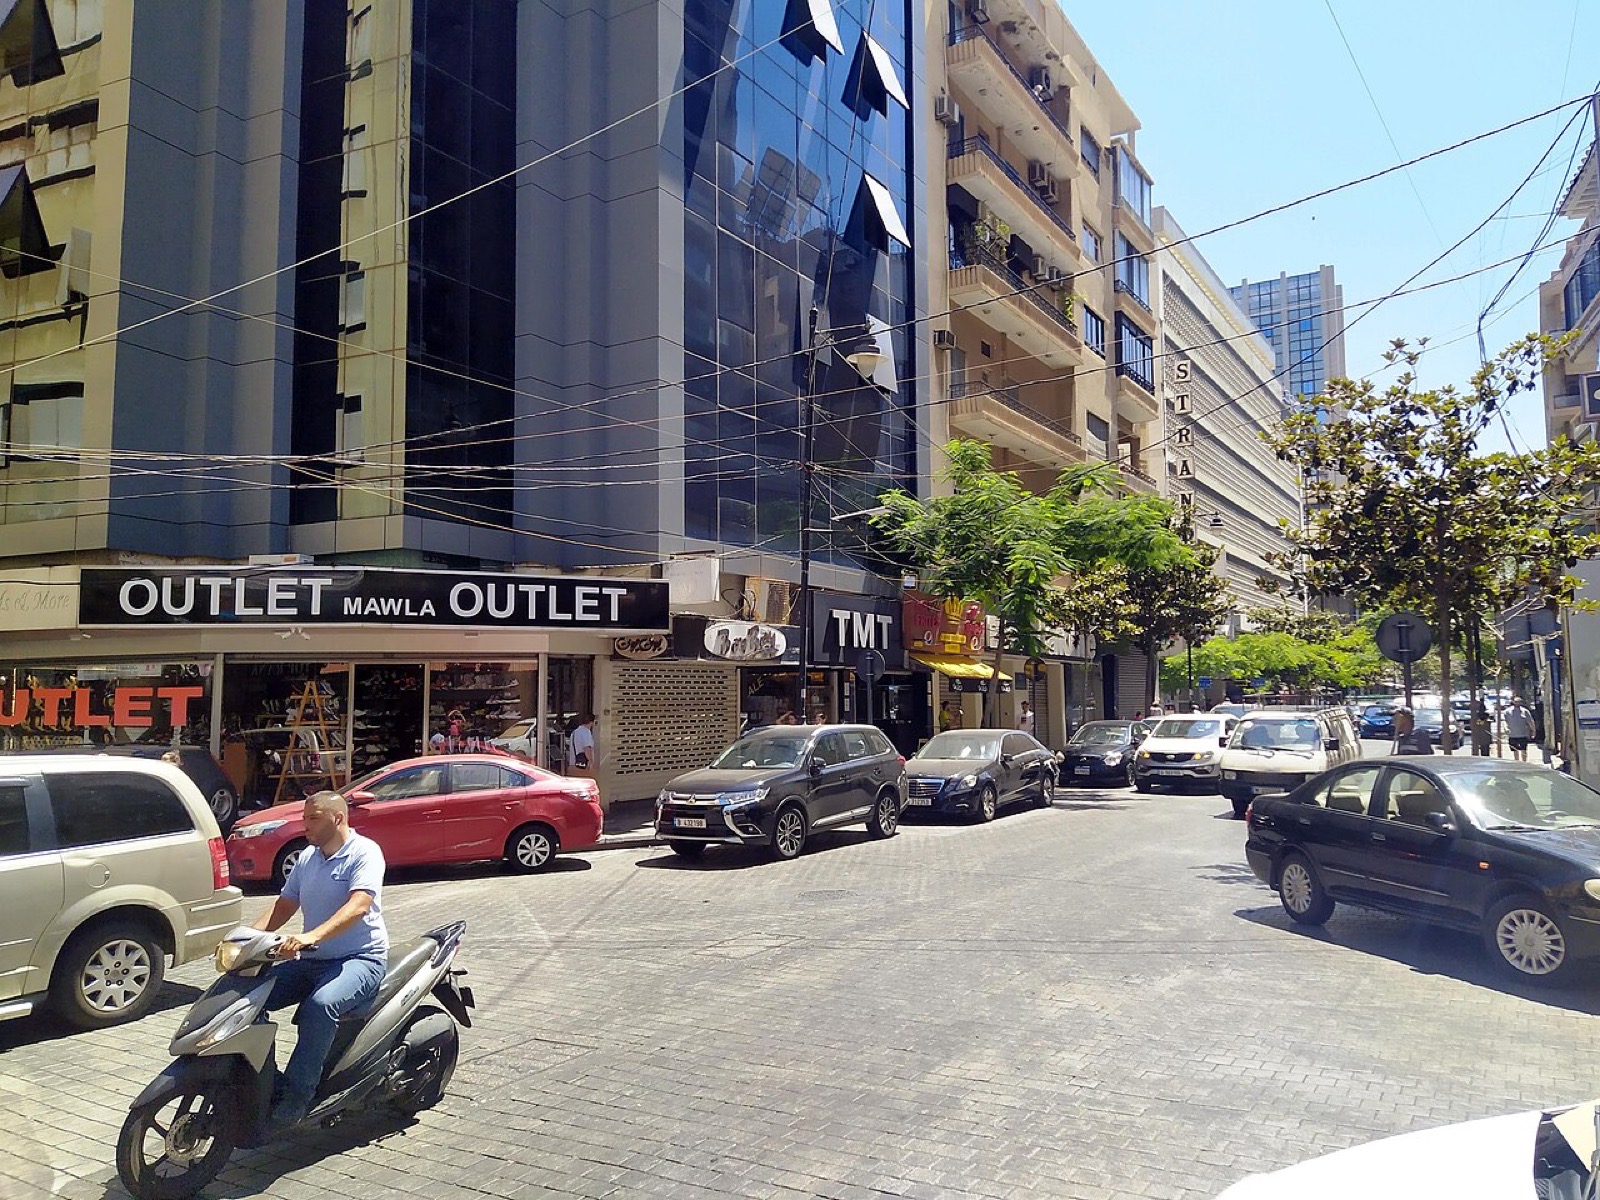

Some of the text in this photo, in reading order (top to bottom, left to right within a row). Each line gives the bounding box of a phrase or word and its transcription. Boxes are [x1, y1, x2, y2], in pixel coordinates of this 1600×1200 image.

[119, 577, 627, 622] OUTLET MAWLA OUTLET
[833, 609, 892, 650] TMT
